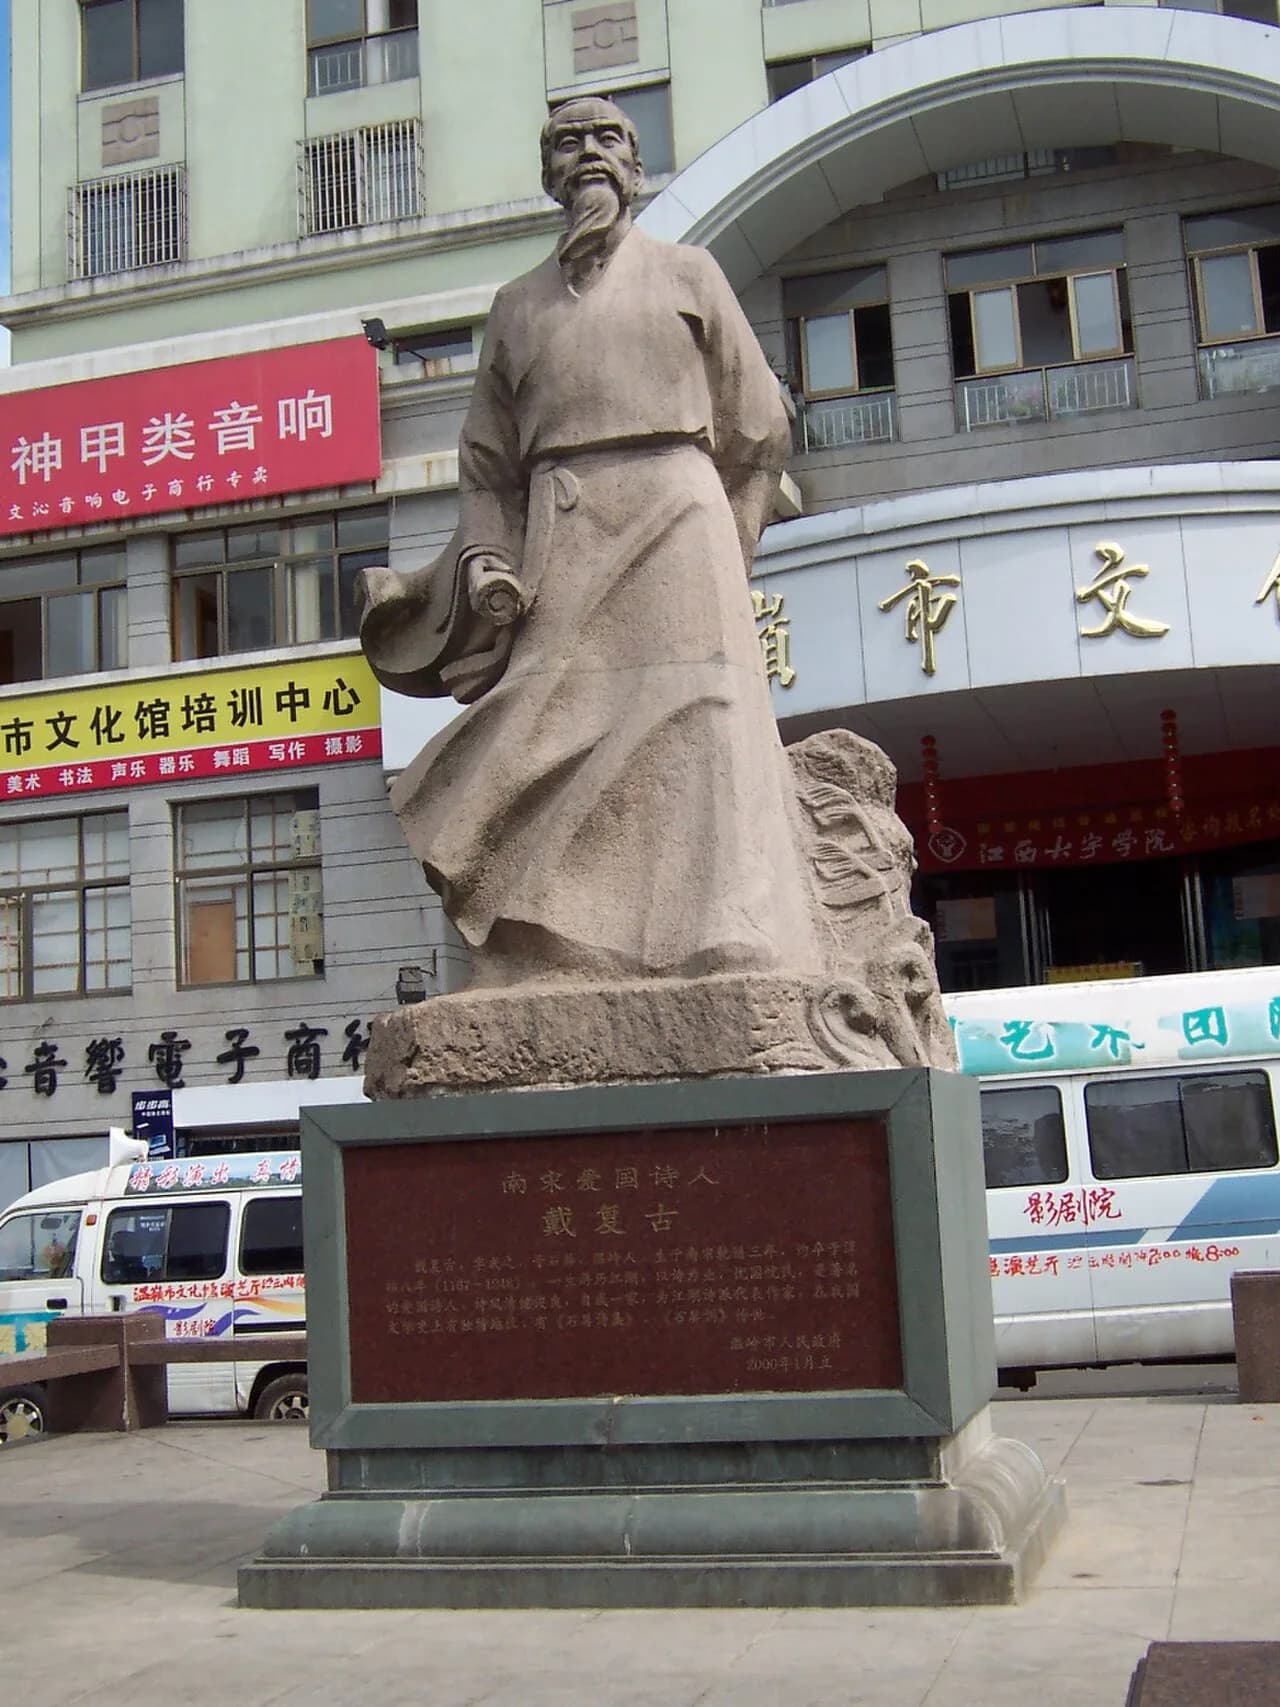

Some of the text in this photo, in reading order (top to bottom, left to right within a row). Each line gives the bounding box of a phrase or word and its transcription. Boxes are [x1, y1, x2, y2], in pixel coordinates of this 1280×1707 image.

[10, 389, 332, 485] 神甲类音响
[751, 540, 1280, 690] 市文
[1, 677, 361, 755] 市文化馆培训中心
[7, 735, 363, 793] 美术 书法 声乐 器乐 舞蹈 写作 摄影
[0, 1018, 374, 1097] 音響電子商
[542, 1204, 680, 1238] 戴复古
[1023, 1187, 1123, 1227] 影剧院
